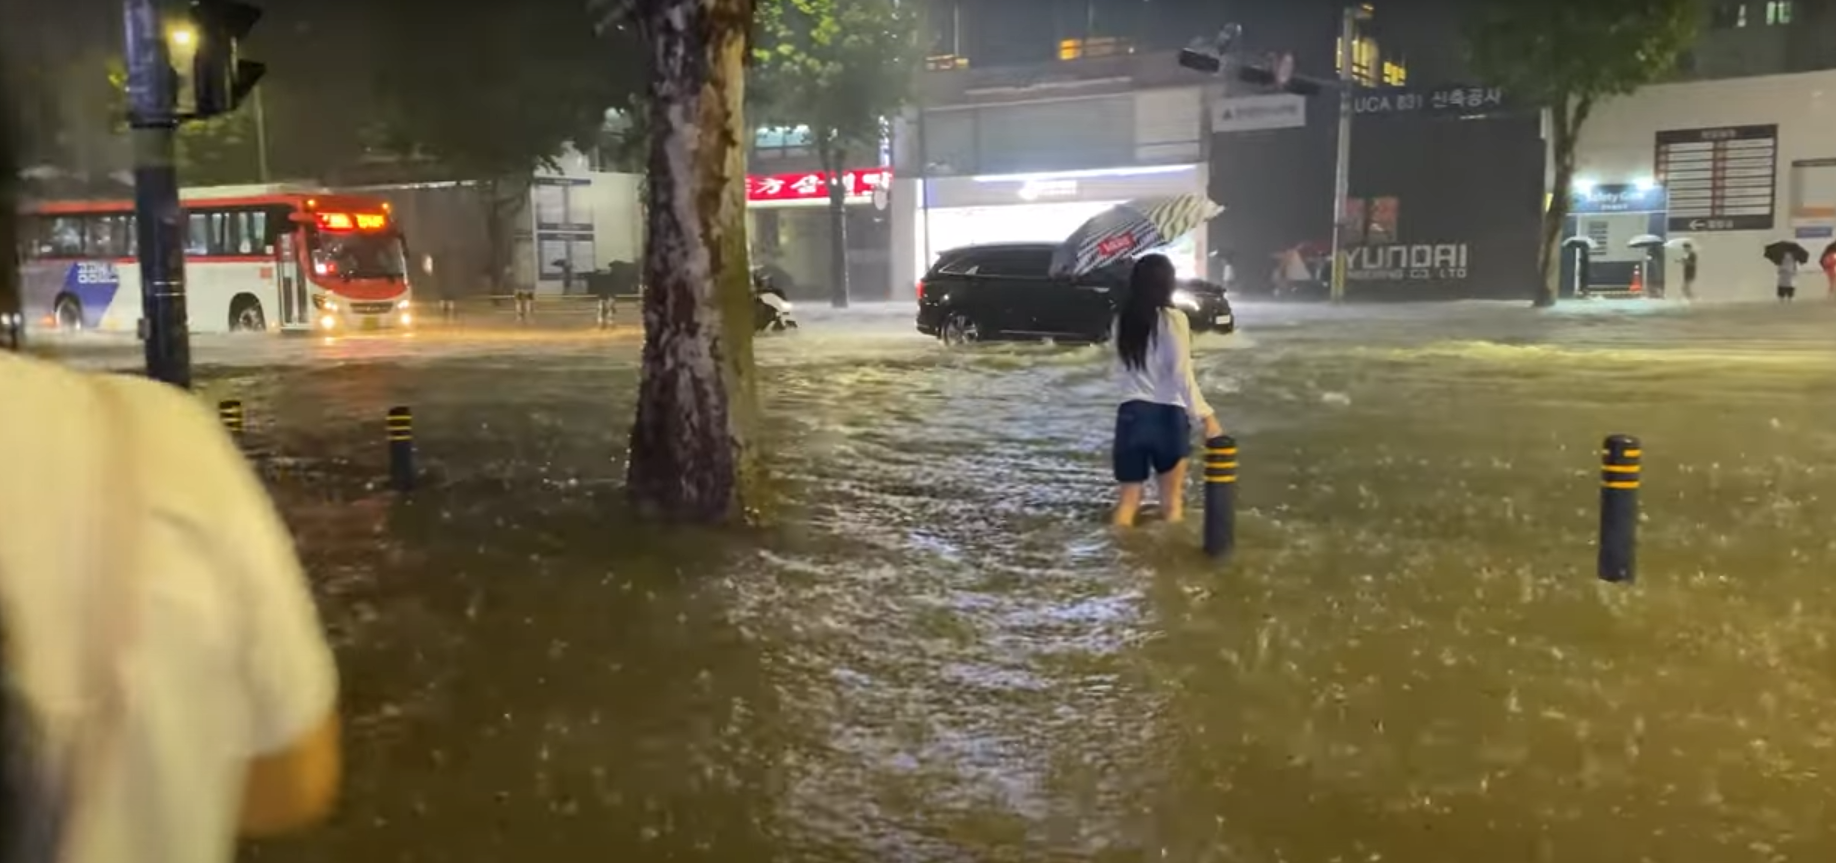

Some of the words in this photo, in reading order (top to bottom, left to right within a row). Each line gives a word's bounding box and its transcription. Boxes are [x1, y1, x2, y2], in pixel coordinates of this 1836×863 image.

[1353, 96, 1392, 113] UCA
[1431, 87, 1502, 109] 신축공사
[1346, 244, 1467, 269] YUNDAI
